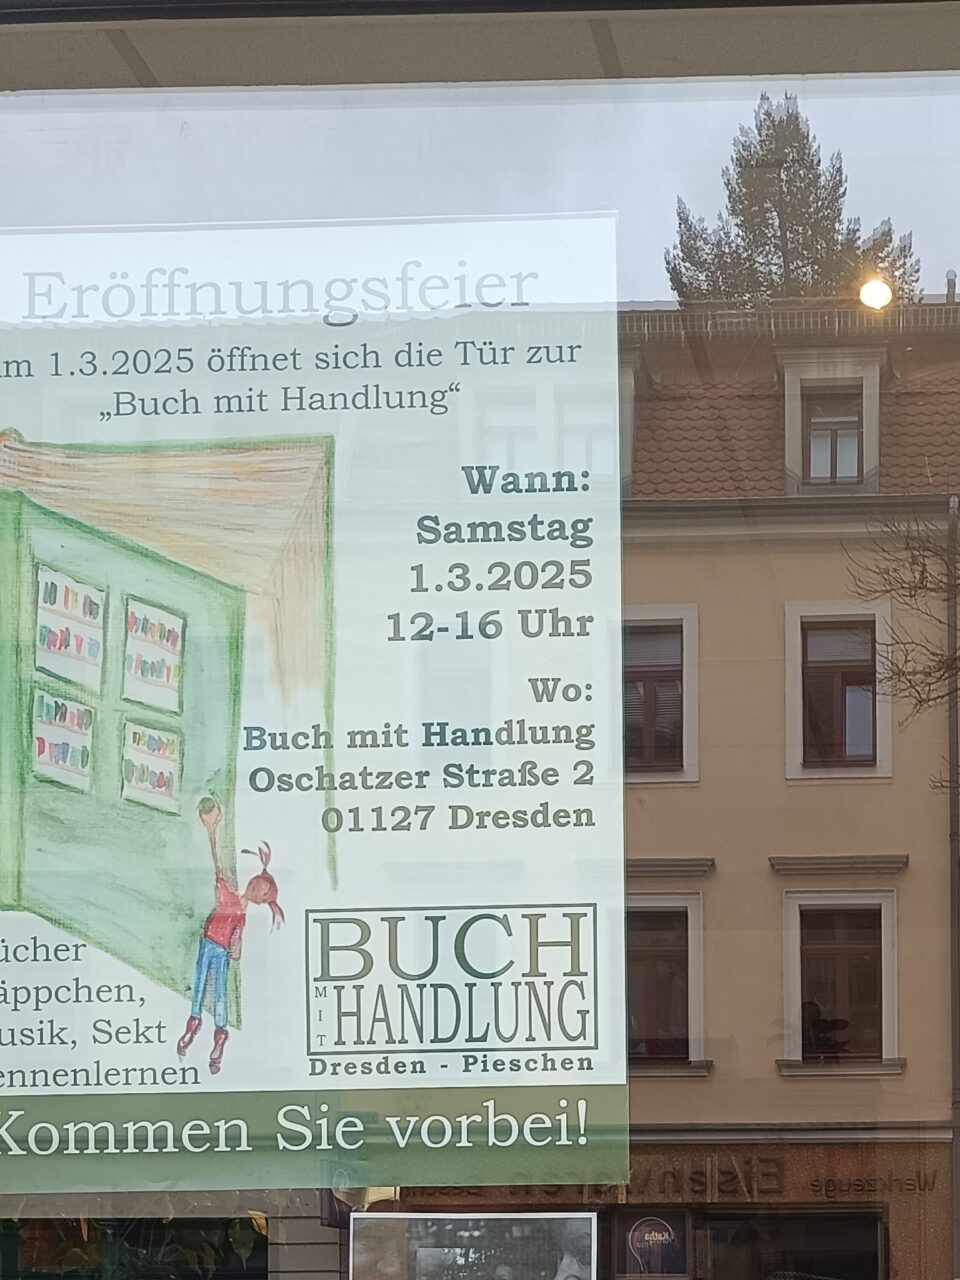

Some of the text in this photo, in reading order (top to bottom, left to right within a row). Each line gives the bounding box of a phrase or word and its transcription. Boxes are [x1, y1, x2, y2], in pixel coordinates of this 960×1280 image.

[22, 260, 539, 326] Eröffnungsfeier
[0, 340, 582, 378] m 1.3.2025 öffnet sich die Tür zur
[214, 386, 269, 413] mit
[461, 466, 591, 495] Wann:
[416, 513, 593, 548] Samstag
[410, 560, 593, 593] 1.3.2025
[387, 608, 594, 642] 12-16 Uhr
[529, 678, 593, 702] Wo:
[243, 719, 595, 753] Buch mit Handlung
[248, 760, 595, 792] Oschatzer Straße 2
[321, 803, 595, 833] 01127 Dresden
[313, 912, 588, 983] BUCH
[333, 980, 591, 1046] HANDLUNG
[91, 1018, 166, 1044] Sekt
[309, 1053, 594, 1076] Dresden Pieschen
[276, 1104, 365, 1150] Sie
[385, 1099, 588, 1148] vorbei!
